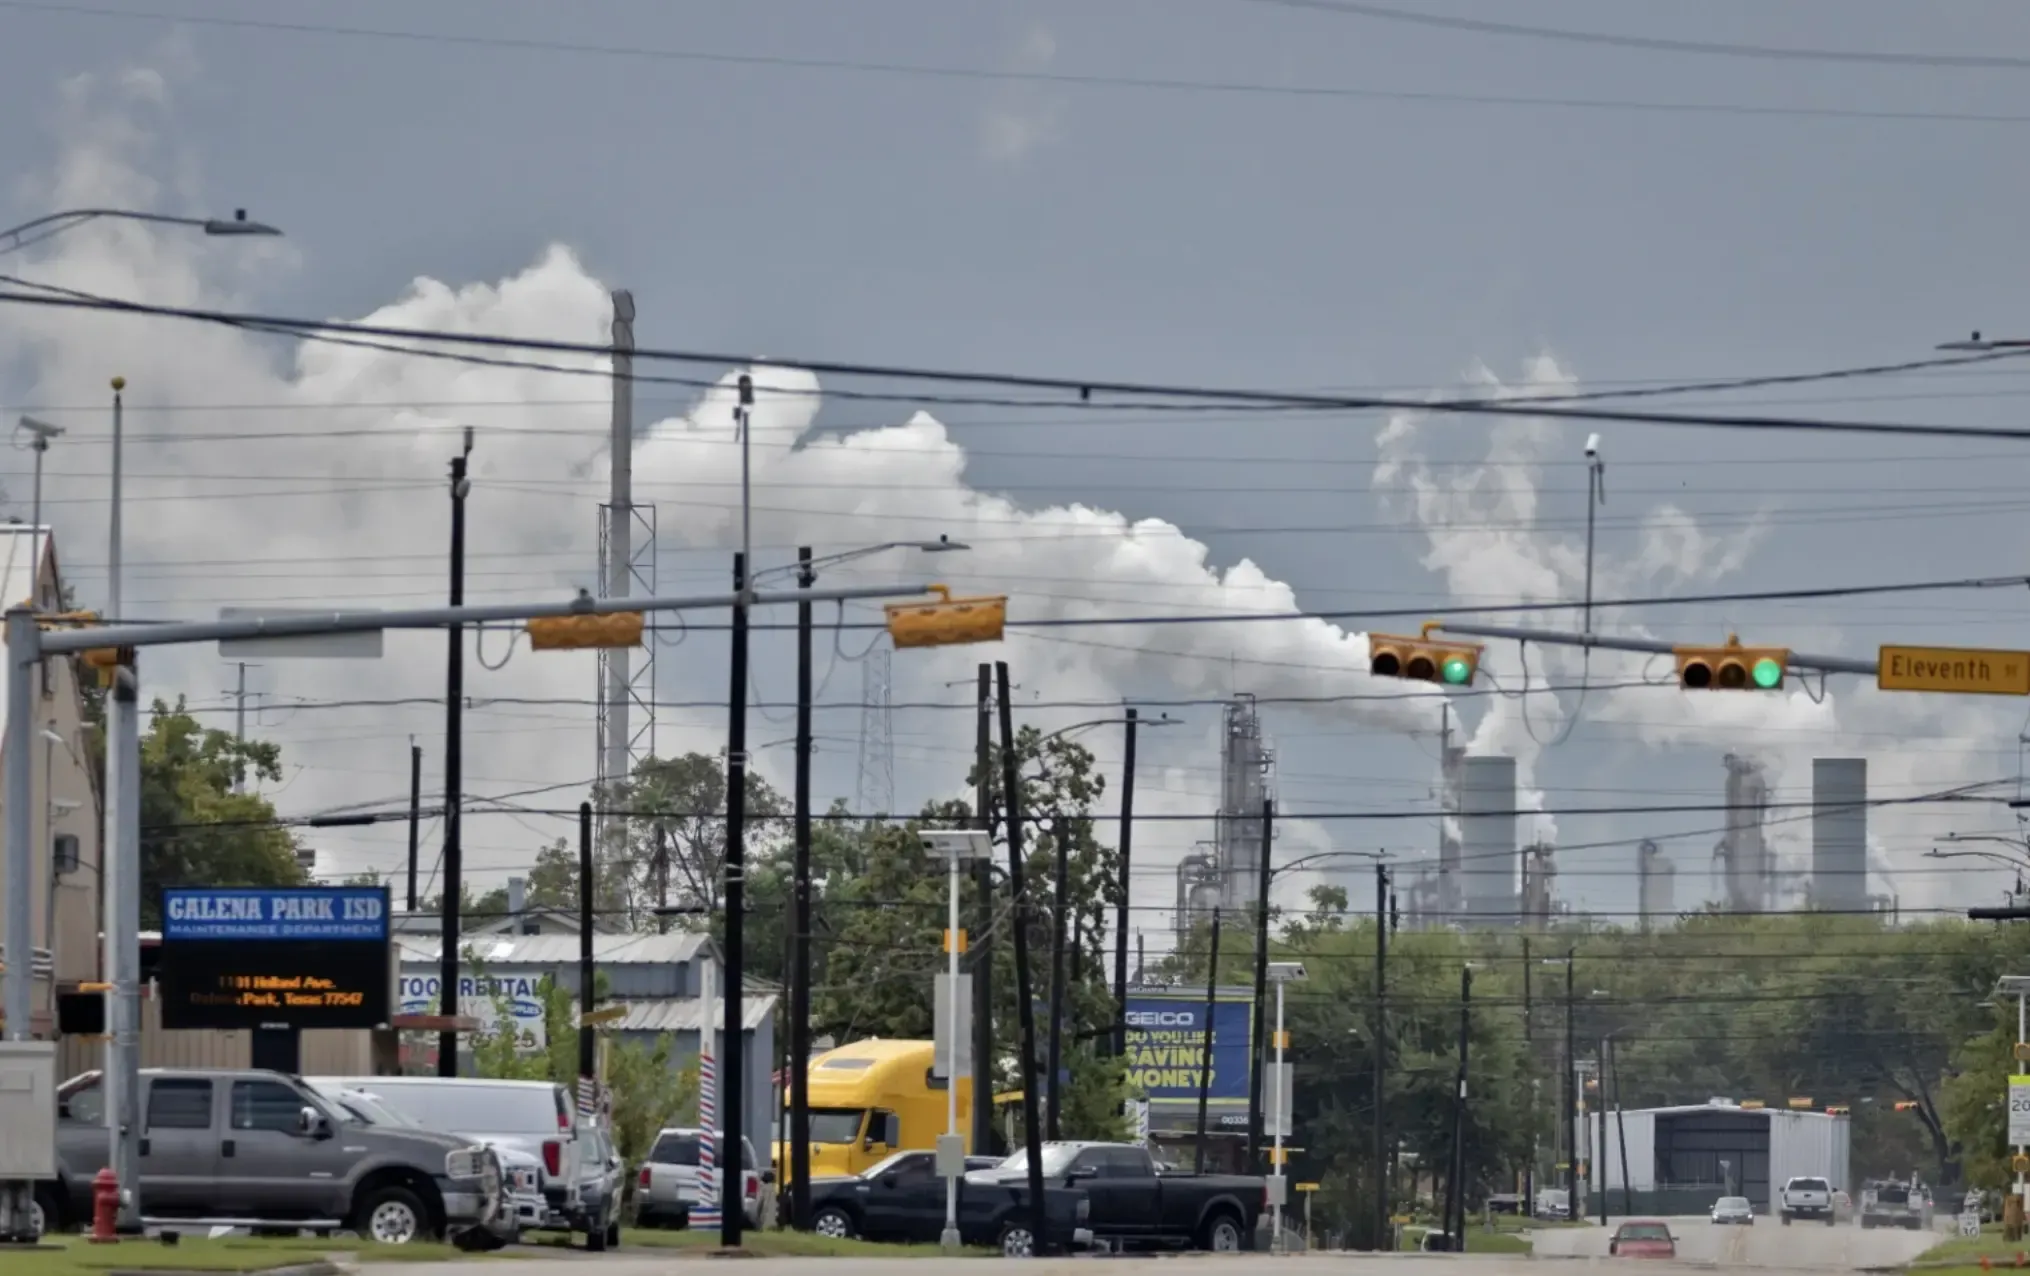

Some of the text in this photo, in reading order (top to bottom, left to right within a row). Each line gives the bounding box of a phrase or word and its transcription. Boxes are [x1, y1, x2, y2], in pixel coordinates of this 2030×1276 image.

[1891, 655, 1990, 681] Eleventh
[168, 897, 382, 920] GALENA PARK ISD
[169, 923, 381, 934] MAINTENANCE DEPARTMENT
[303, 976, 337, 989] Ave.
[398, 977, 442, 997] TOO
[243, 992, 281, 1007] Park,
[284, 992, 322, 1006] Texas
[1124, 1011, 1194, 1026] GEICO
[1151, 1031, 1182, 1044] YOU
